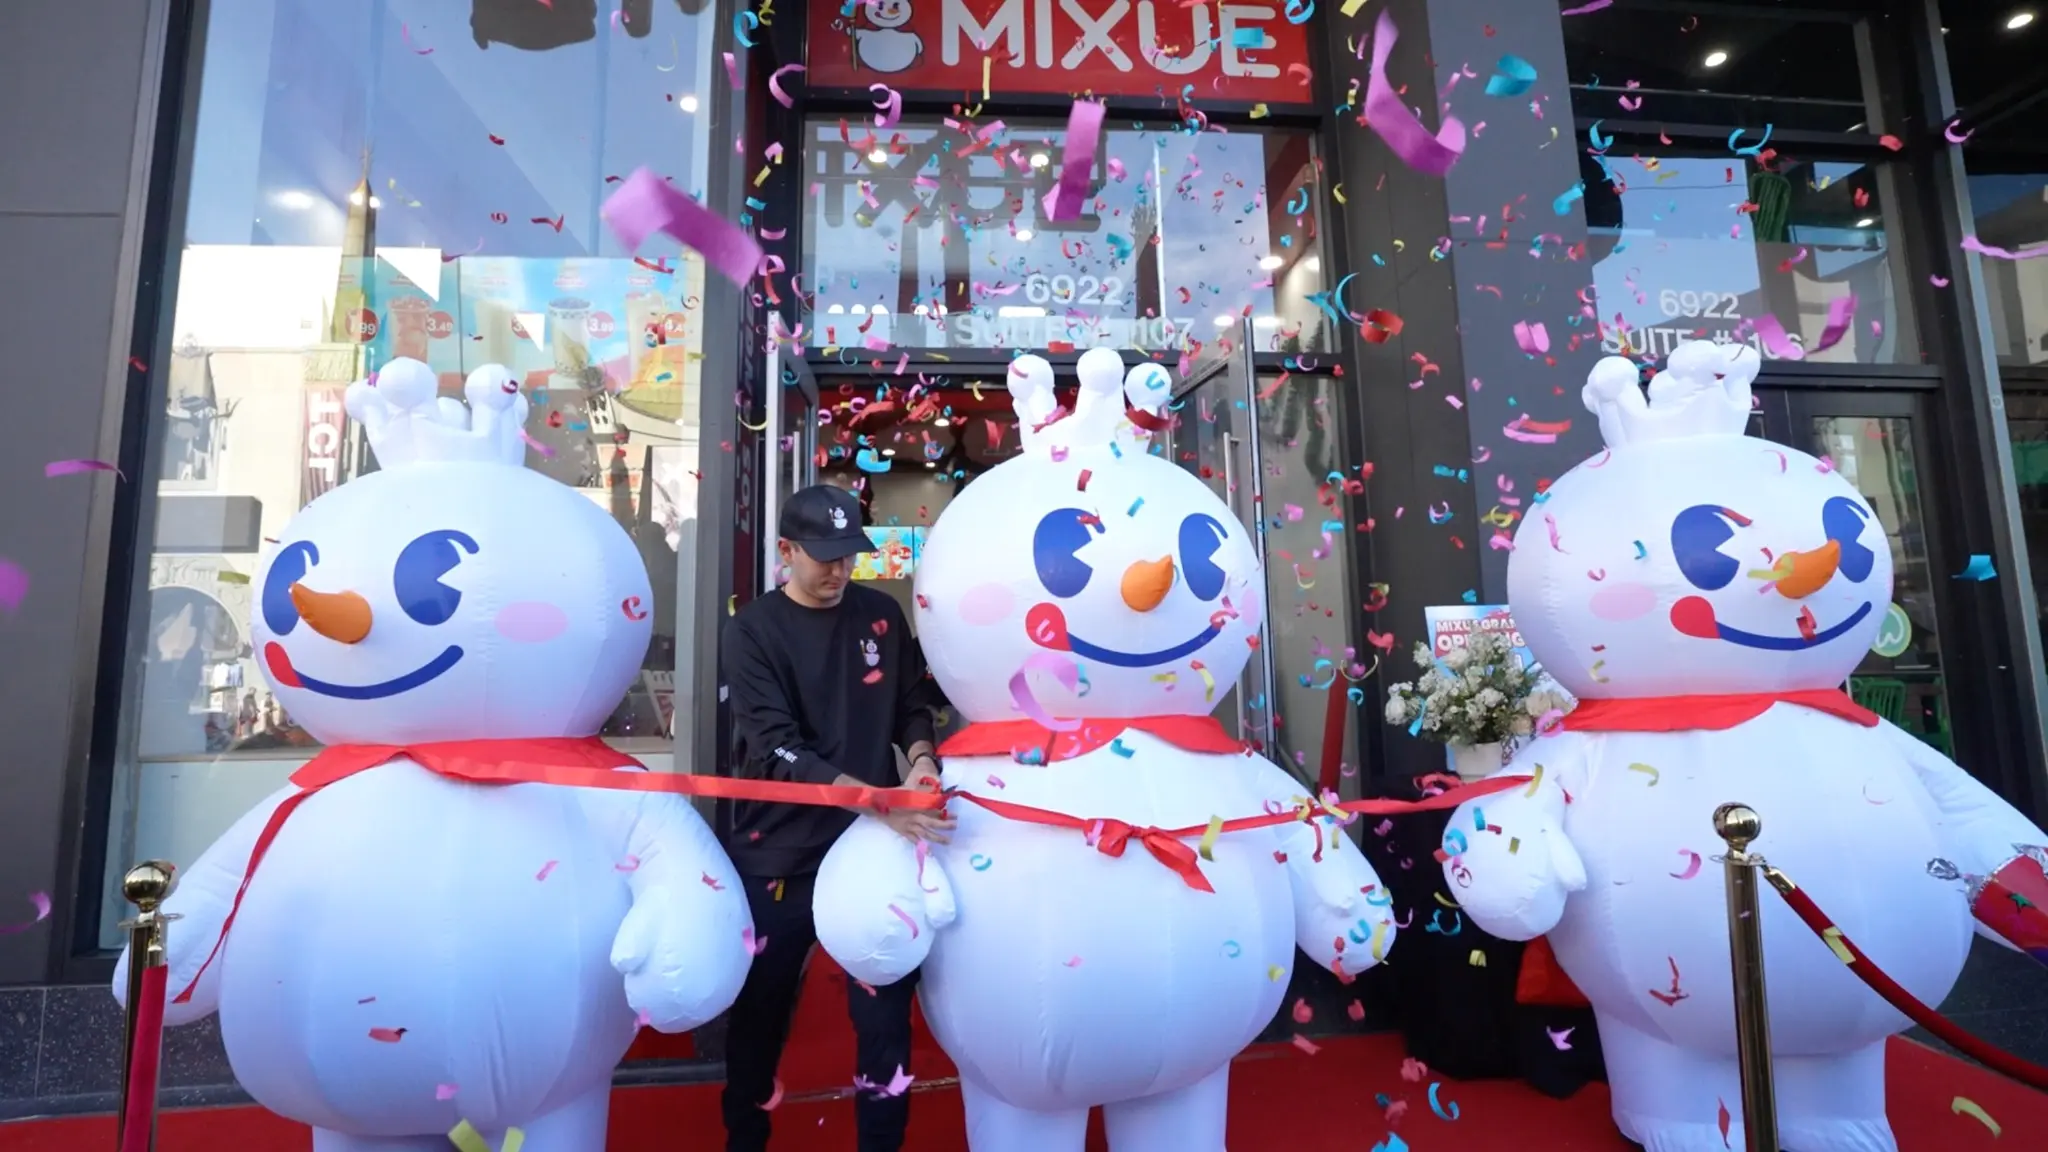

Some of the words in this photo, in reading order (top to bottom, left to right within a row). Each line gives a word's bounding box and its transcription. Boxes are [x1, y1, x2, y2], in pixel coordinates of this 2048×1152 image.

[942, 0, 1281, 78] MIXUE
[1026, 274, 1125, 306] 6922
[1660, 289, 1741, 319] 6922
[1601, 327, 1695, 356] SUITE
[1481, 618, 1516, 630] GRAN
